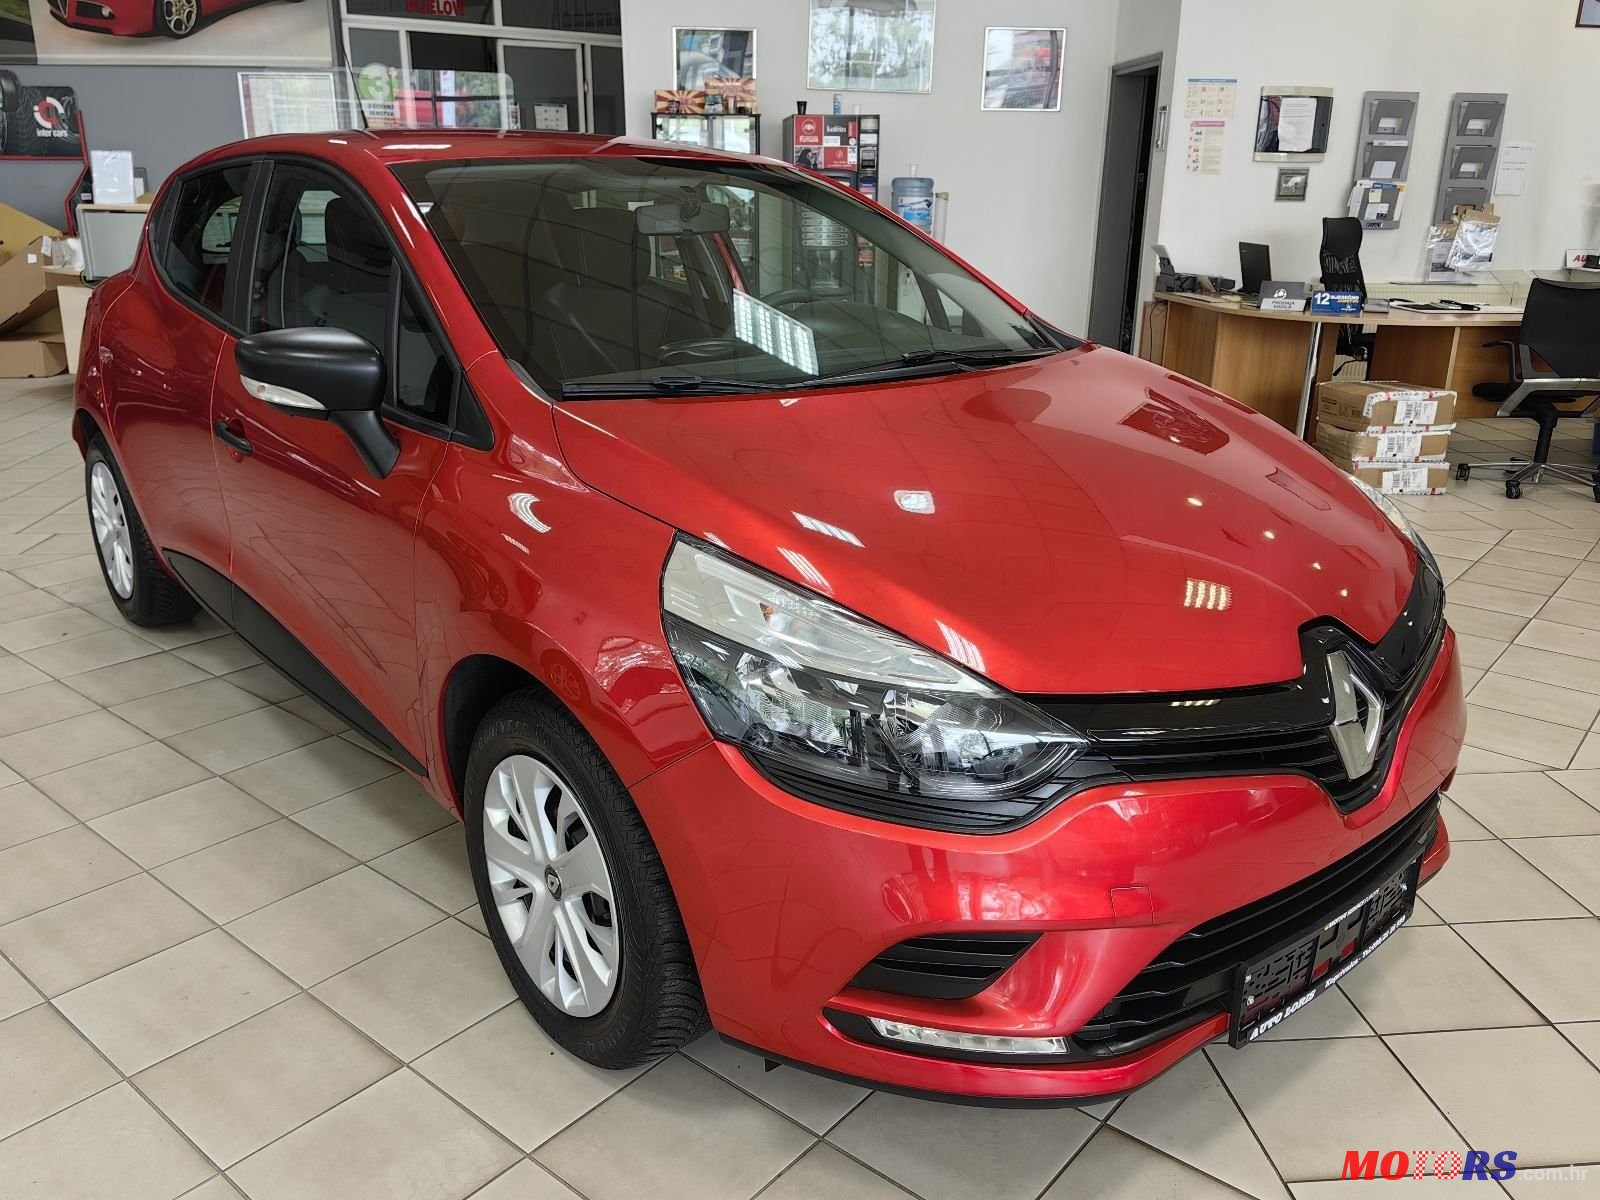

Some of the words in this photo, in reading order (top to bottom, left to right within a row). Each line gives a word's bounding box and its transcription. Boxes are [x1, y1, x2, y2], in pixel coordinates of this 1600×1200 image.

[36, 128, 52, 137] inter
[52, 129, 69, 138] cars
[1314, 292, 1331, 305] 12
[1249, 1011, 1284, 1041] AUTO
[1283, 988, 1317, 1019] LORIS
